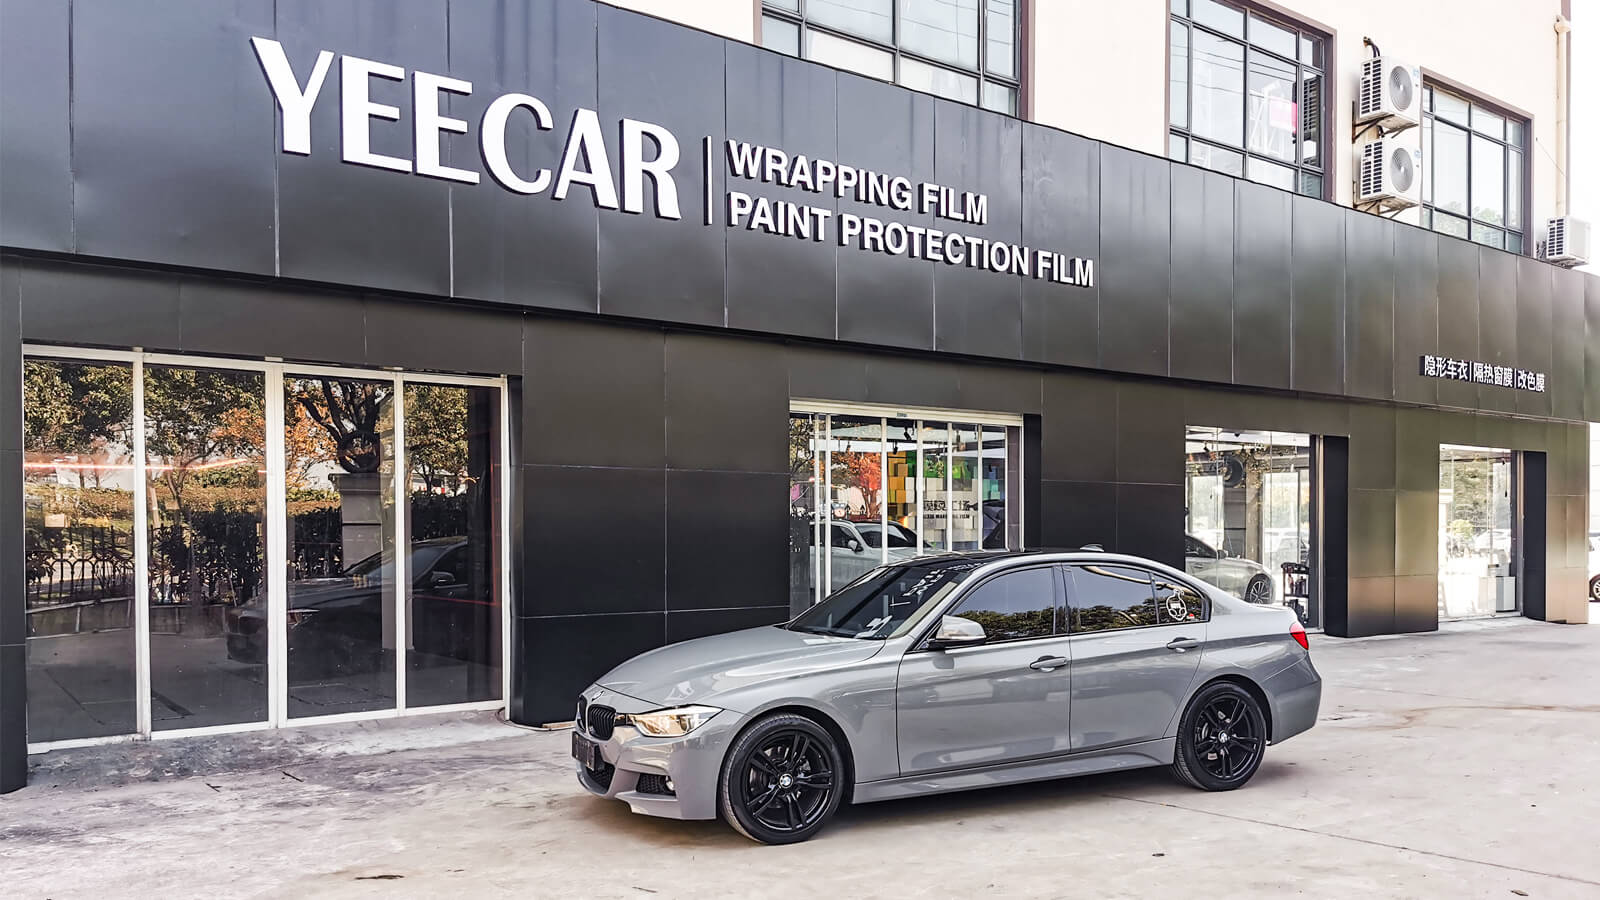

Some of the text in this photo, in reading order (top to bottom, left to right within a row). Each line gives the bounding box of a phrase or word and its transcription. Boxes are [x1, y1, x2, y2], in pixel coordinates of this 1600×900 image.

[251, 36, 682, 219] YEECAR
[727, 139, 988, 225] WRAPPING FILM
[728, 191, 1094, 287] PAINT PROTECTION FILM
